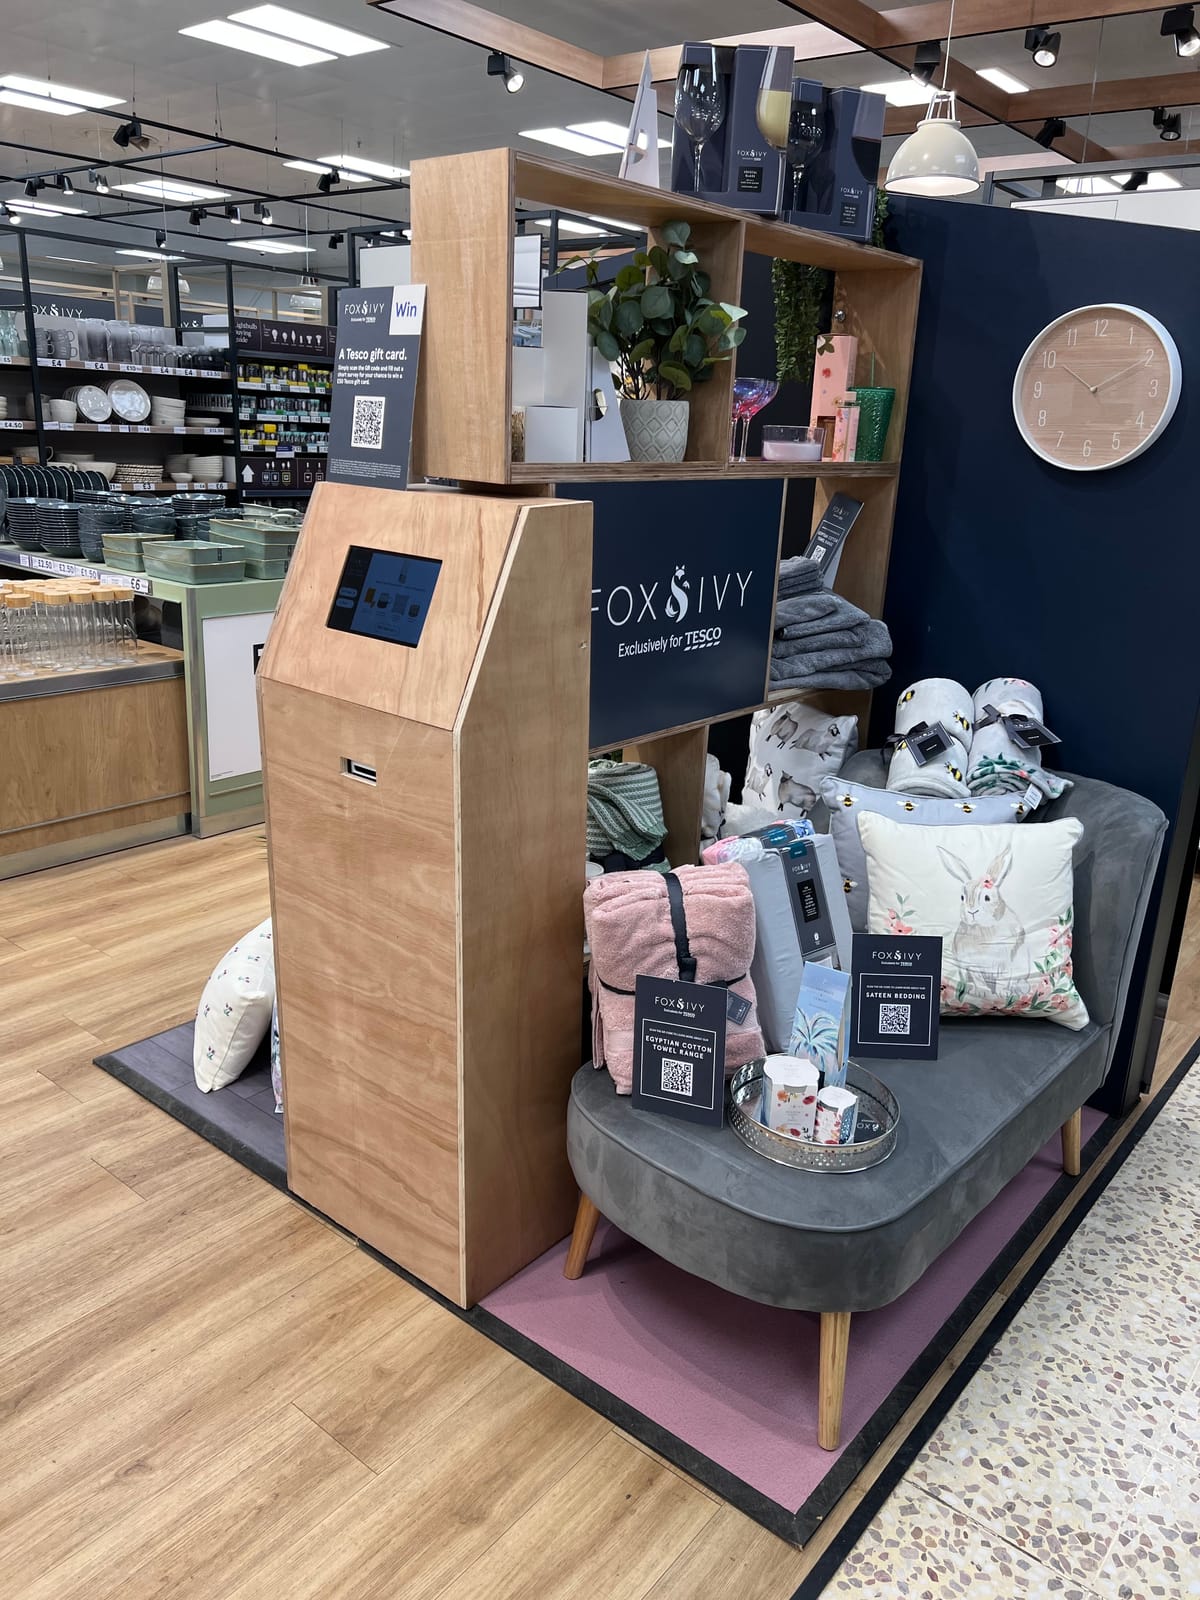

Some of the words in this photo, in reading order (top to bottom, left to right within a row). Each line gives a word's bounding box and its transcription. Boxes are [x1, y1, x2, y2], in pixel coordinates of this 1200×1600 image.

[32, 304, 48, 316] OX
[61, 307, 82, 318] IVY
[344, 304, 361, 314] FOX
[368, 303, 384, 314] IVY
[396, 302, 416, 317] Win
[1094, 320, 1108, 336] 12
[1128, 327, 1134, 345] 1
[1066, 328, 1078, 346] 11
[338, 348, 344, 360] A
[346, 348, 368, 360] Tesco
[370, 348, 384, 363] gift
[386, 348, 408, 360] card.
[1042, 350, 1056, 368] 10
[1144, 349, 1154, 367] 2
[1034, 382, 1042, 398] 9
[1148, 380, 1158, 398] 3
[1038, 410, 1047, 426] 8
[1136, 411, 1144, 429] 4
[1056, 430, 1064, 448] 7
[1112, 432, 1120, 450] 5
[1082, 440, 1092, 456] 6
[38, 560, 52, 569] £2.50
[130, 578, 140, 590] £6
[698, 570, 753, 614] IVY
[618, 637, 668, 658] Exclusively
[669, 634, 683, 649] for
[684, 626, 722, 647] TESCO
[872, 951, 892, 960] FOX
[903, 952, 922, 960] IVY
[654, 996, 675, 1008] FOX
[686, 1002, 704, 1012] IVY
[645, 1035, 680, 1047] EGYPTIAN
[682, 1042, 712, 1054] COTTON
[652, 1044, 677, 1054] TOWEL
[680, 1049, 704, 1060] RANGE
